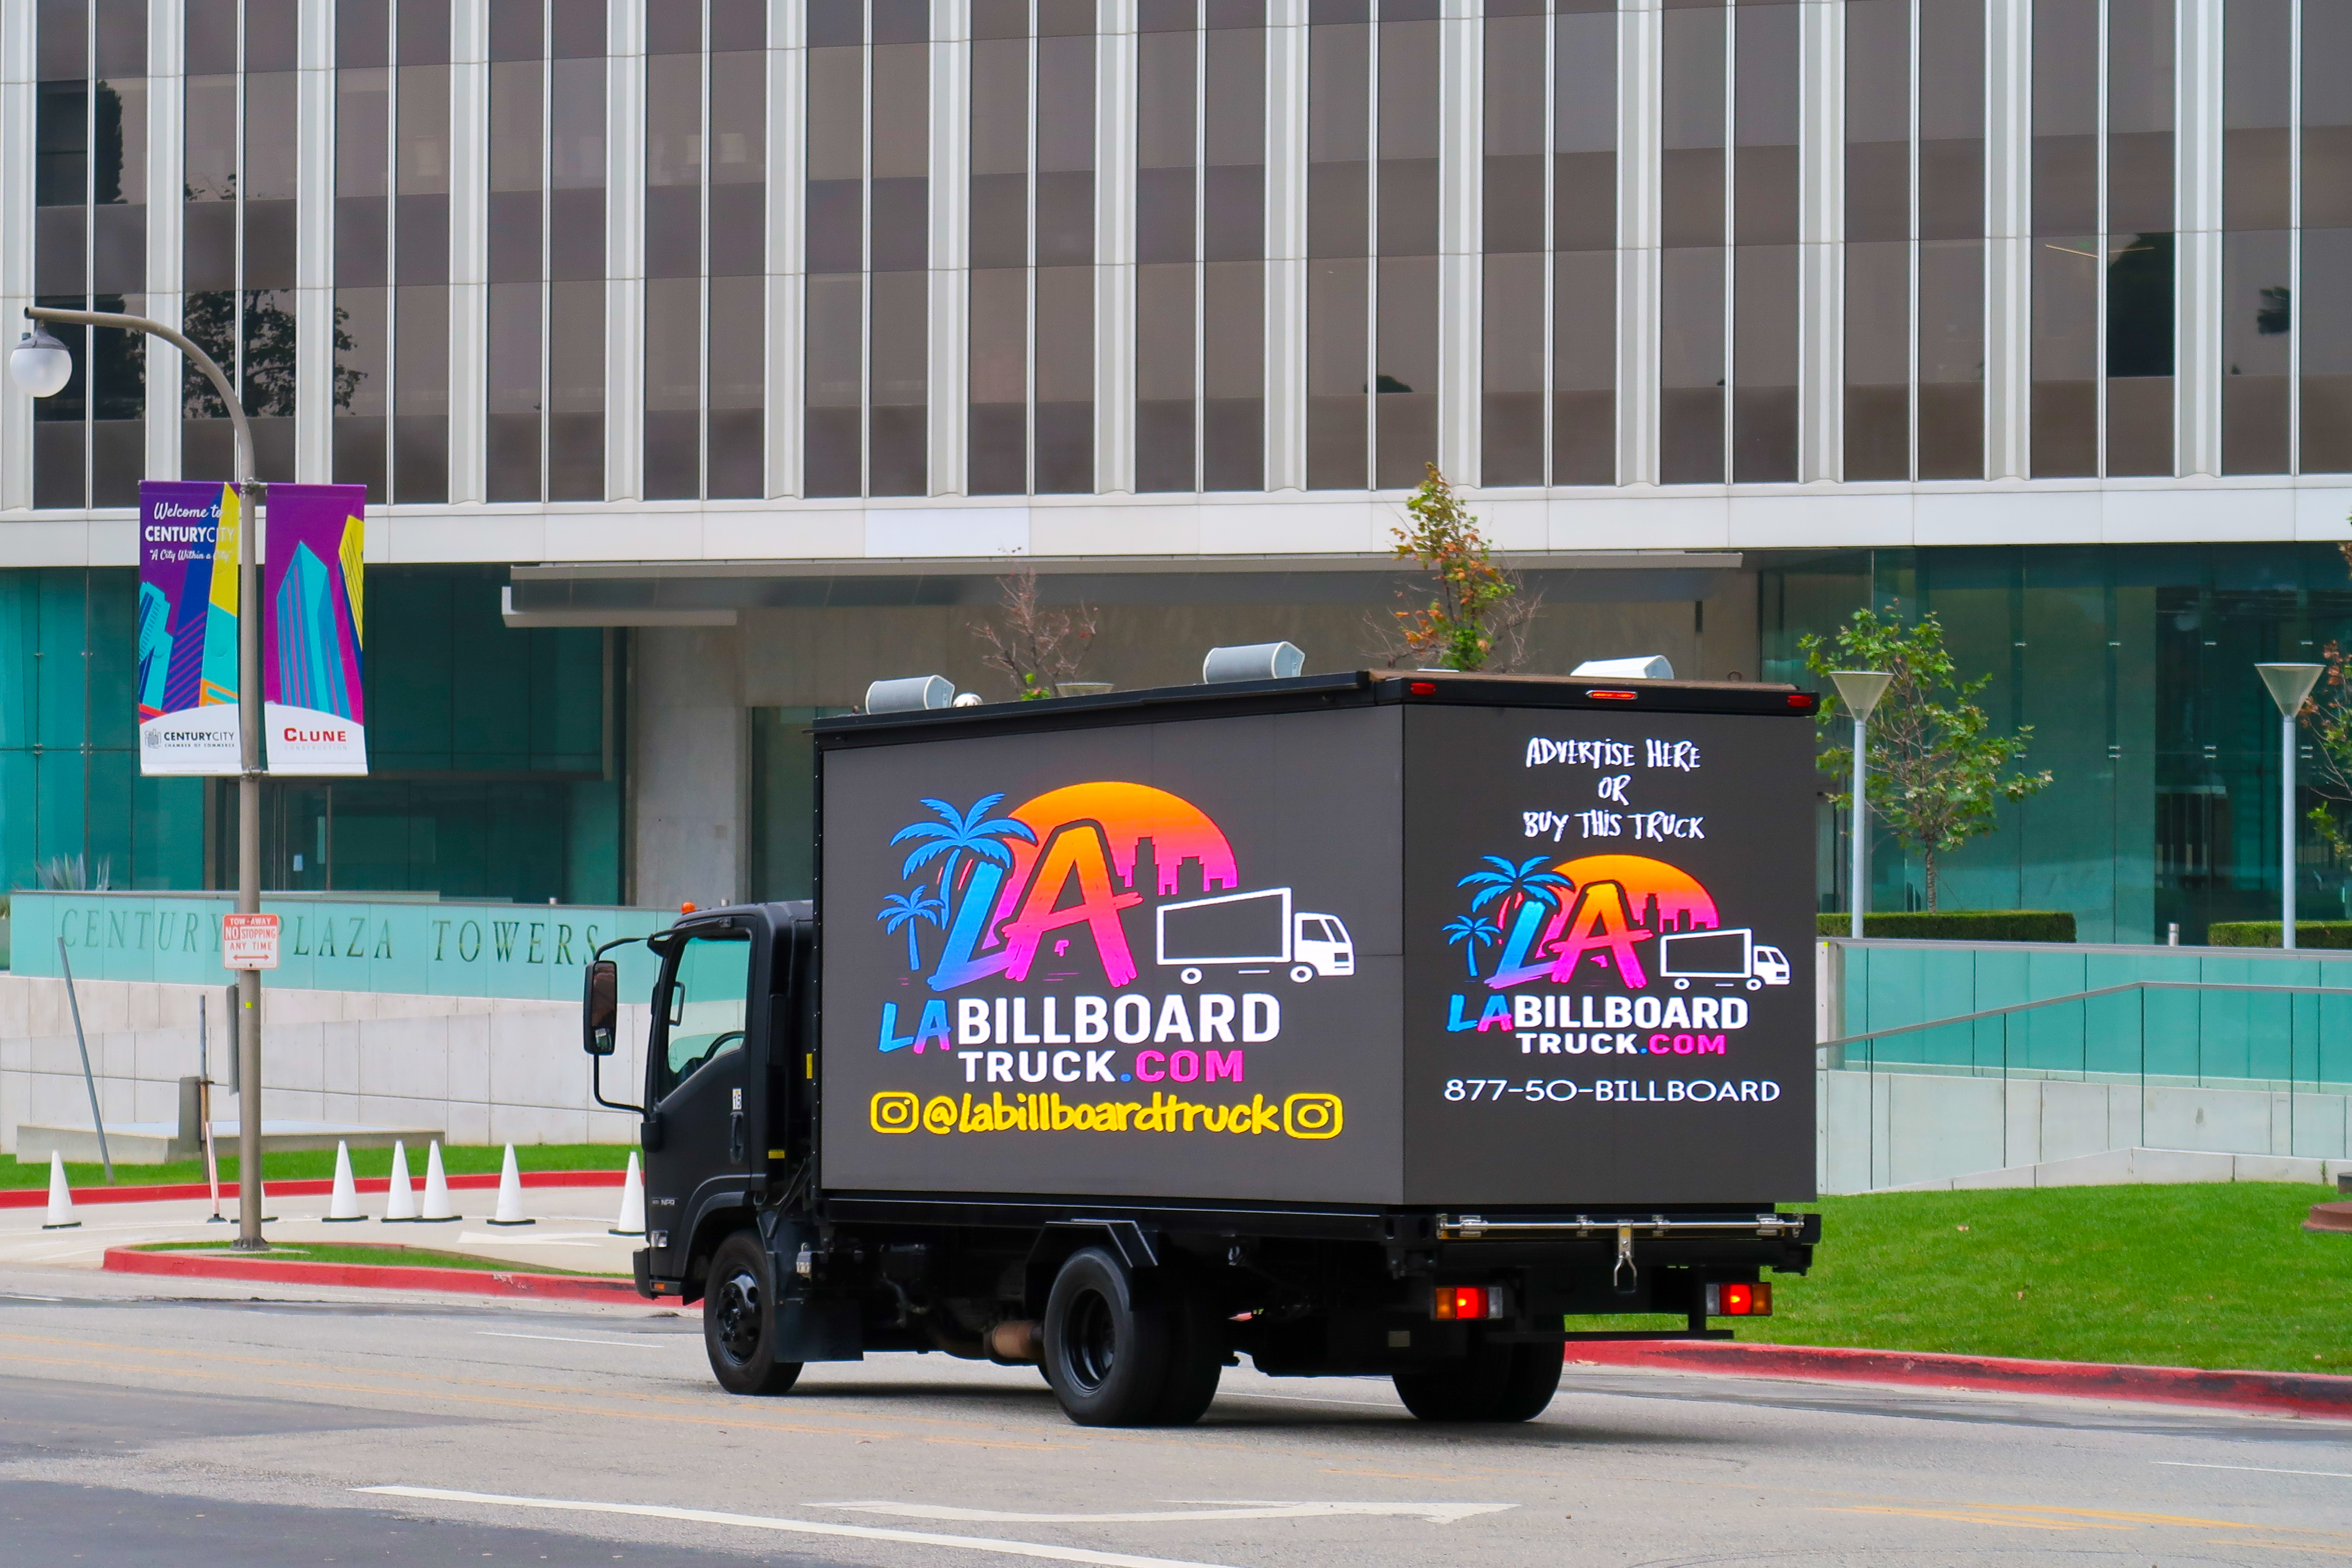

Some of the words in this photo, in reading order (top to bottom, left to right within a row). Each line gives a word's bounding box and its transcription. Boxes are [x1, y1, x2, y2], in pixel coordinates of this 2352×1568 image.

[154, 502, 209, 520] Welcome
[210, 504, 224, 518] to
[145, 526, 234, 543] CENTURYCITY
[160, 549, 176, 563] City
[178, 550, 204, 561] Within
[164, 732, 234, 741] CENTURYCITY
[1645, 738, 1701, 772] HERE
[1597, 774, 1631, 805] OR
[1522, 810, 1569, 842] BUY
[1574, 809, 1623, 838] THIS
[1627, 811, 1706, 842] TRUCK
[926, 824, 1144, 992] LA
[61, 908, 223, 953] CENTURY
[278, 915, 392, 959] LAZA
[432, 919, 598, 965] TOWERS
[225, 926, 239, 940] NO
[241, 929, 276, 939] STOPPING
[230, 942, 247, 951] ANY
[252, 942, 272, 951] TIME
[1483, 881, 1655, 989] LA
[1515, 1032, 1726, 1056] TRUCK.COM
[957, 1049, 1244, 1083] TRUCK.COM
[1444, 1078, 1780, 1102] 877-50-BILLBOARD
[923, 1091, 1280, 1135] @labillboardtruck
